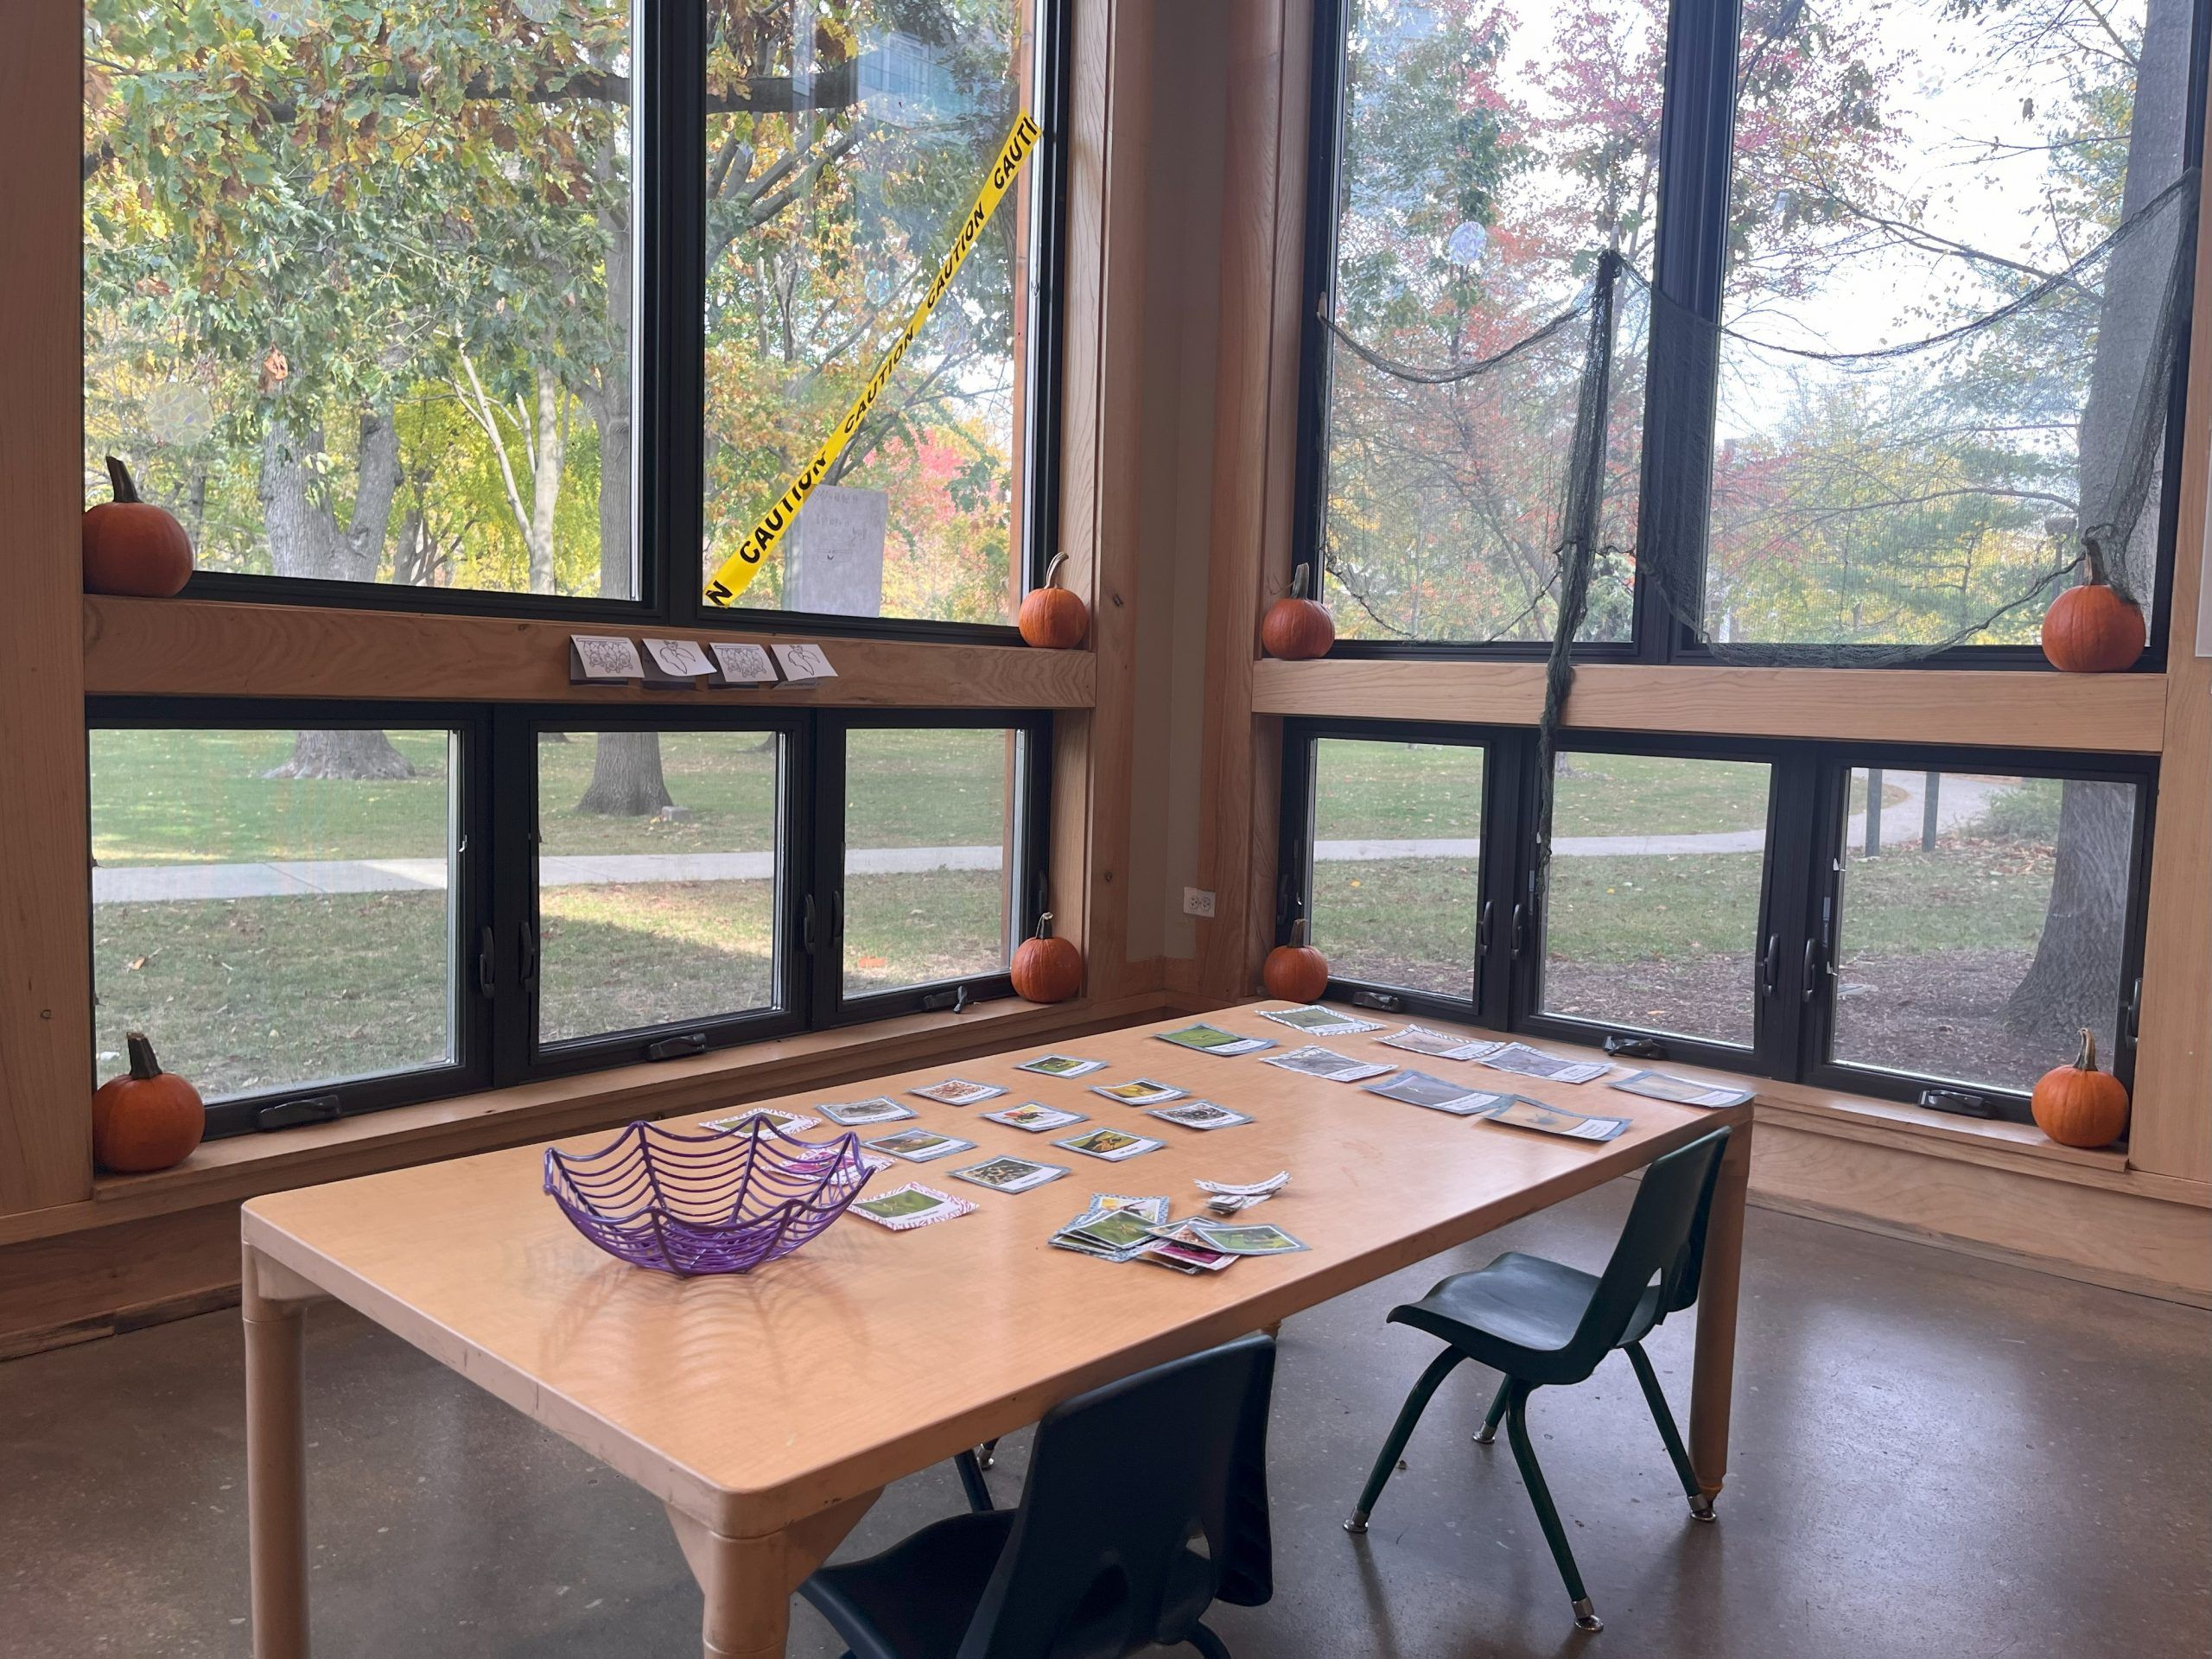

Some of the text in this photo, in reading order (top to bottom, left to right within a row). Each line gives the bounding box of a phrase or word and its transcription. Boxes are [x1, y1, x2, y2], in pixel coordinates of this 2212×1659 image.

[740, 450, 826, 563] CAUTION
[844, 325, 913, 433] CAUTION
[927, 201, 984, 308] CAUTION
[995, 116, 1039, 189] CAUTI
